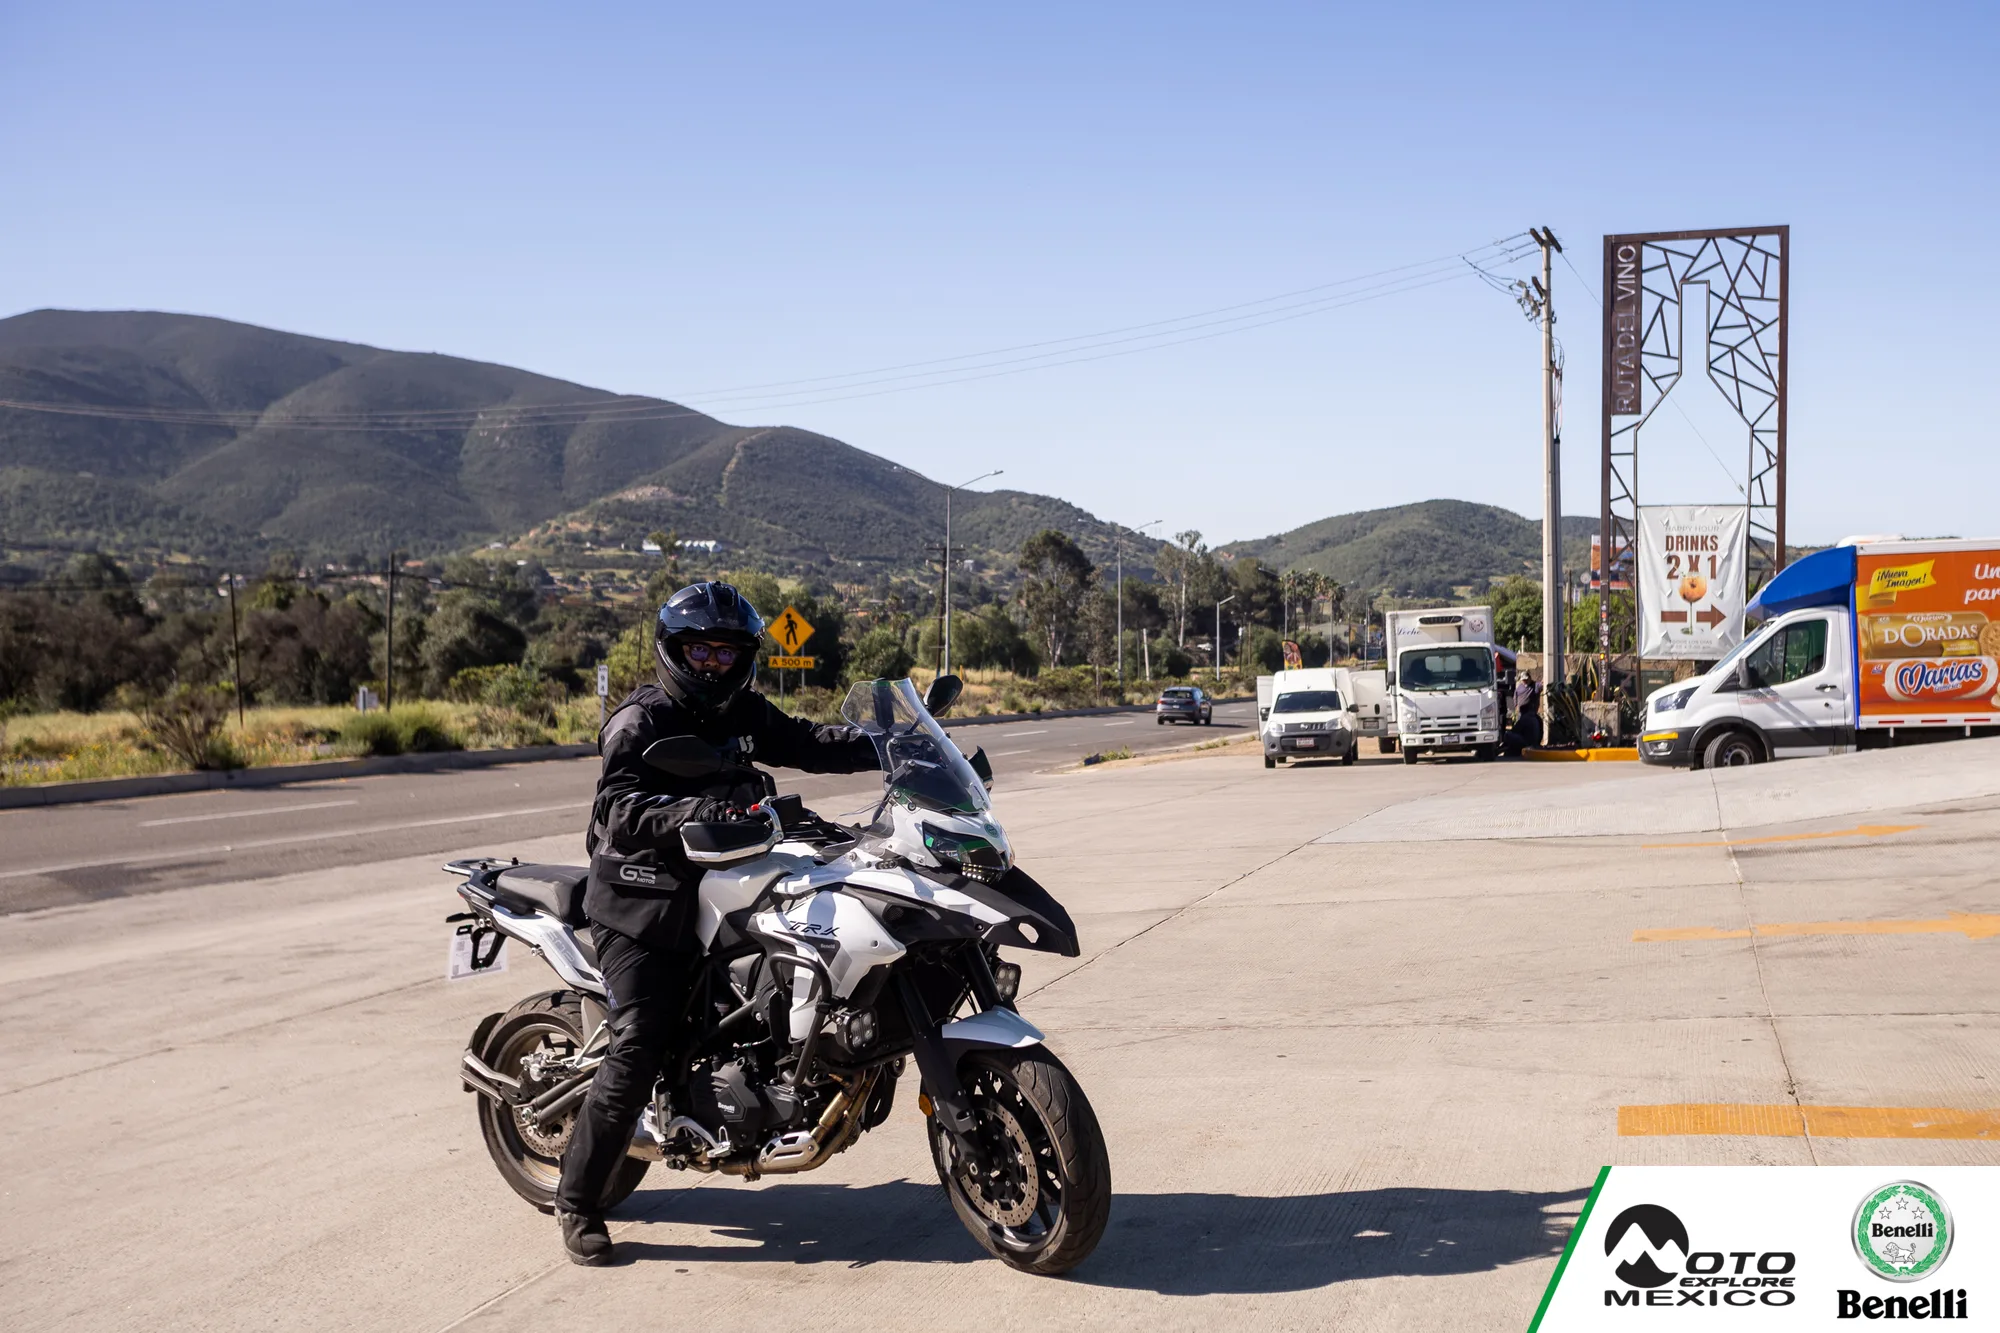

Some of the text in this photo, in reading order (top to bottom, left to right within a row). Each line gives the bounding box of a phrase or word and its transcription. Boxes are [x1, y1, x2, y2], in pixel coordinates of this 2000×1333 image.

[1616, 245, 1636, 412] RUTA DEL VINO
[1665, 525, 1720, 533] HAPPY HOUR
[1665, 535, 1719, 551] DRINKS
[1666, 554, 1681, 580] 2
[1707, 554, 1717, 580] 1
[1877, 570, 1908, 582] ¡Nueva
[1884, 574, 1927, 589] Imagen!
[1884, 623, 1978, 648] DORADAS
[772, 658, 778, 666] A
[782, 658, 800, 666] 500
[619, 864, 657, 881] GS
[637, 877, 656, 885] MOTOS
[789, 920, 840, 937] TRK
